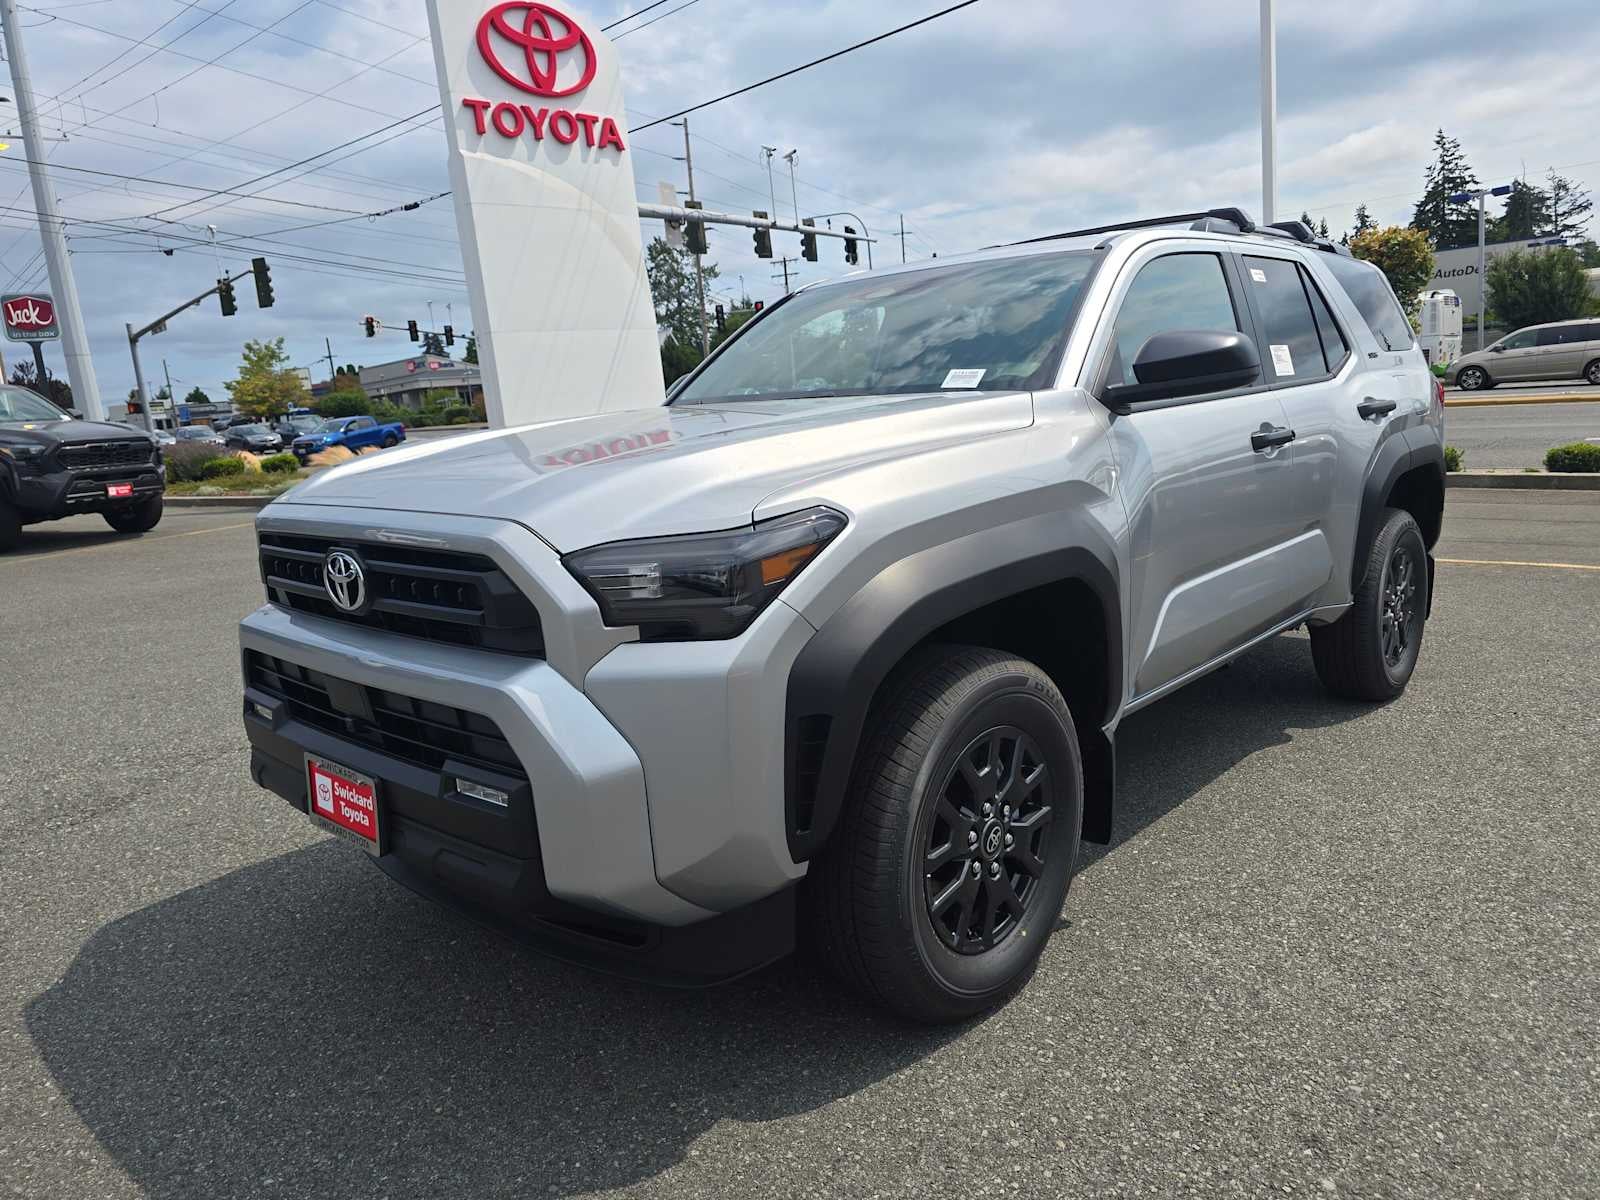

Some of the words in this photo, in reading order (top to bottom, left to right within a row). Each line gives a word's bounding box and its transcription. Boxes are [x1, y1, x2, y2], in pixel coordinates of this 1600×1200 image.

[462, 98, 625, 152] TOYOTA
[7, 299, 53, 326] Jack
[333, 781, 374, 811] Swickard
[339, 801, 370, 826] Toyota
